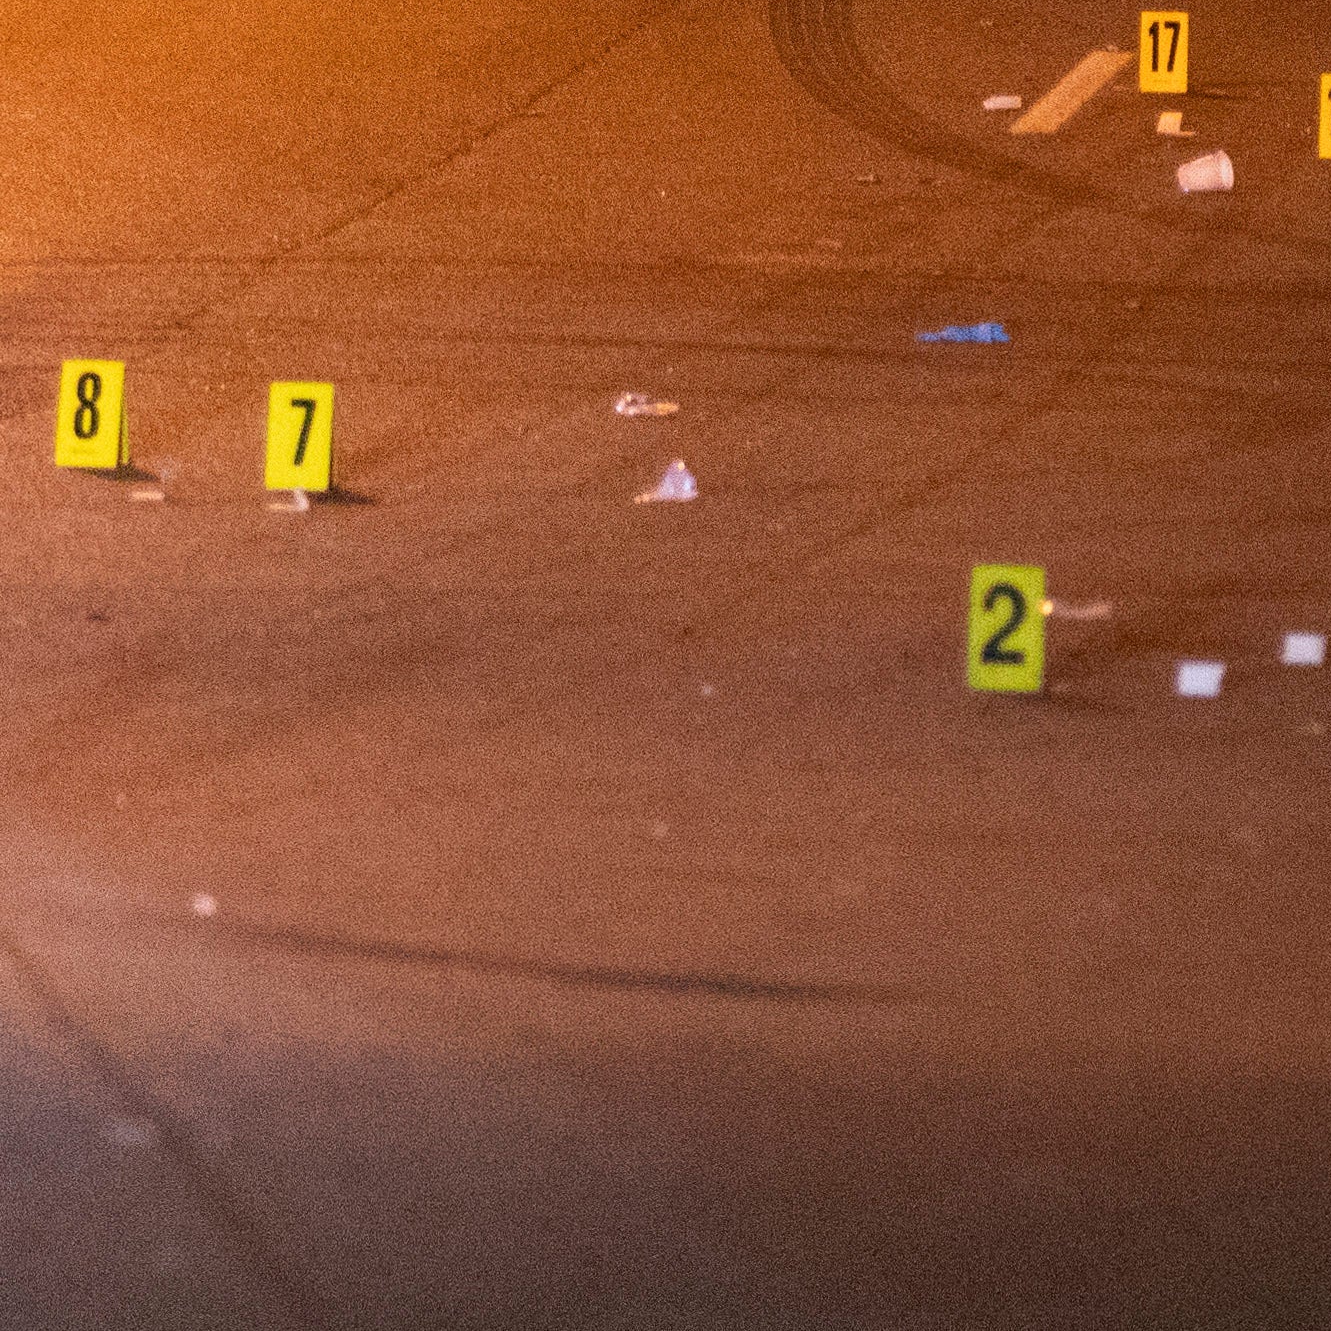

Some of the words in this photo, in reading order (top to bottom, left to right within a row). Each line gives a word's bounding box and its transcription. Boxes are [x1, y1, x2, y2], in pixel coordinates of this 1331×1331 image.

[1148, 19, 1180, 73] 17
[73, 371, 103, 440] 8
[290, 398, 317, 467] 7
[980, 581, 1027, 665] 2
